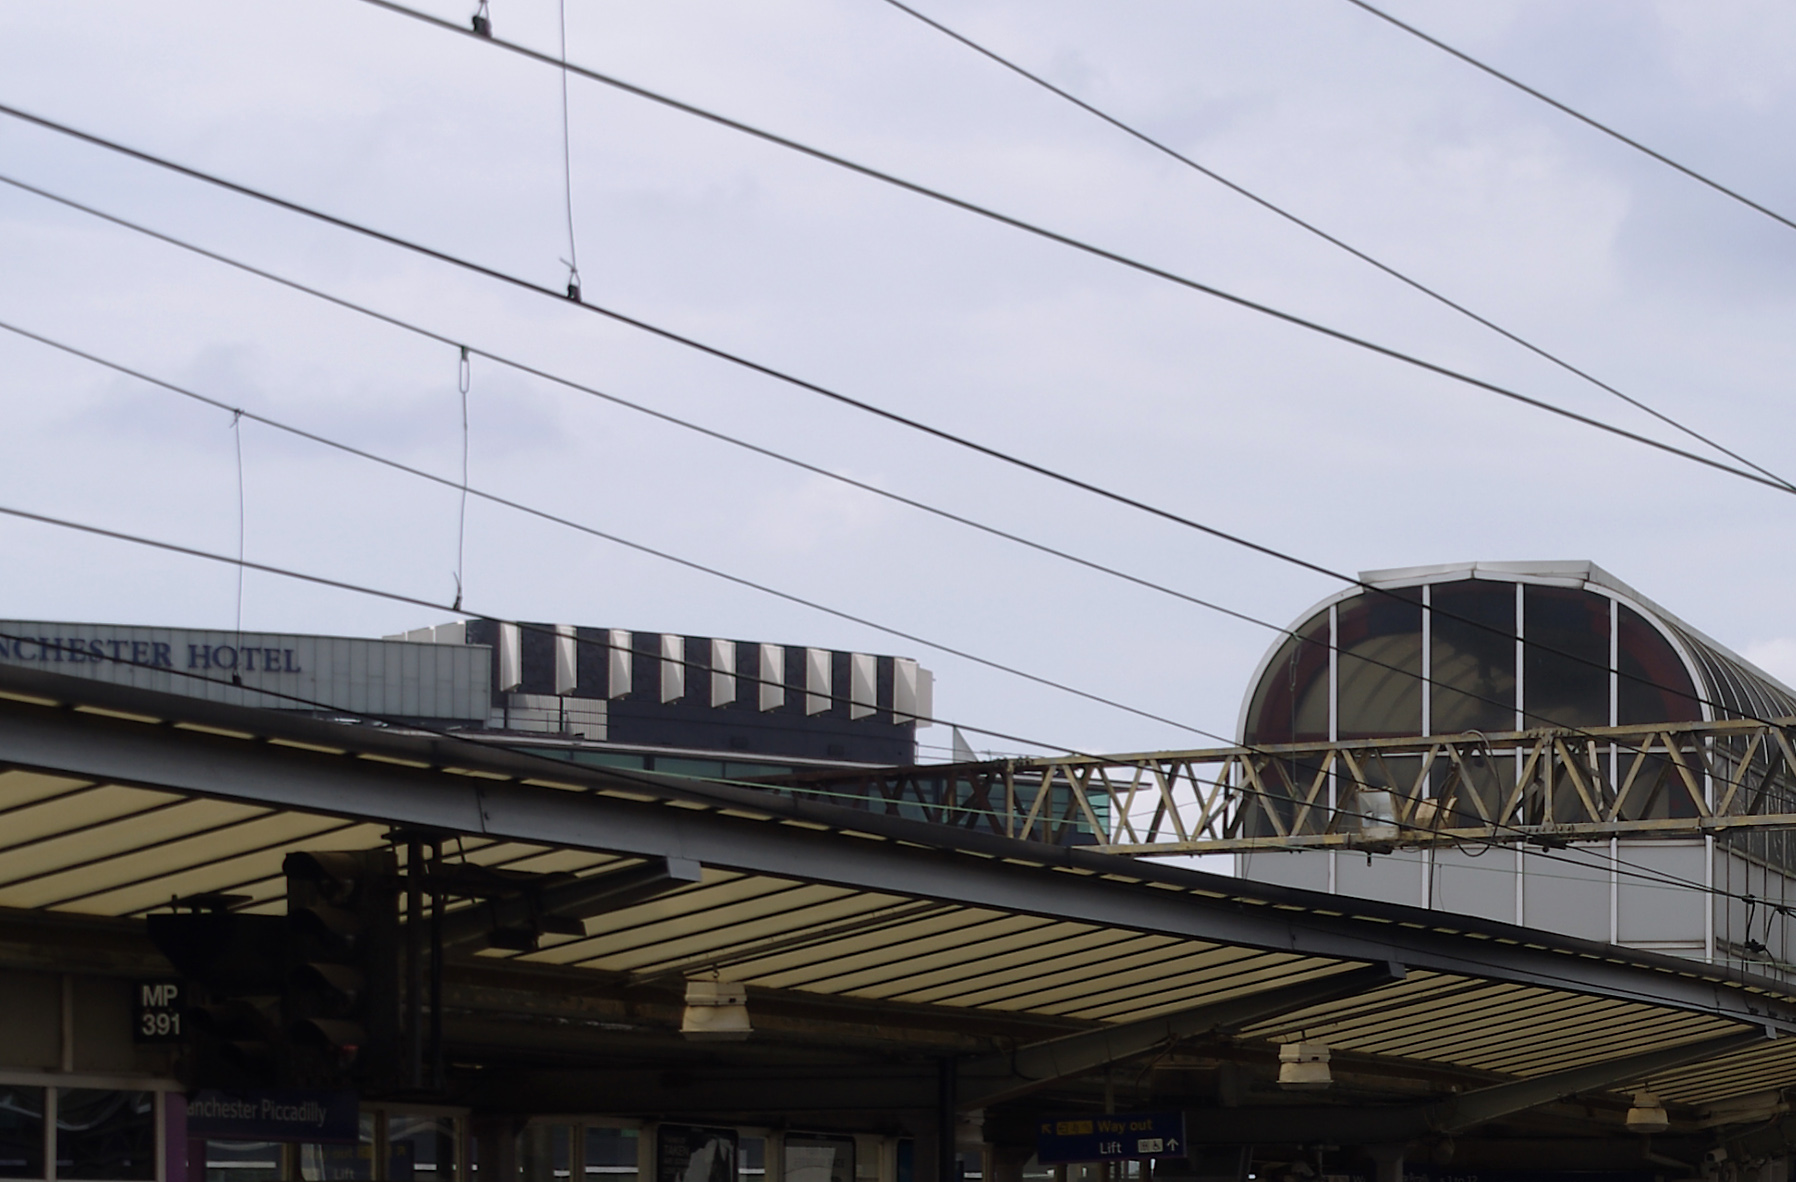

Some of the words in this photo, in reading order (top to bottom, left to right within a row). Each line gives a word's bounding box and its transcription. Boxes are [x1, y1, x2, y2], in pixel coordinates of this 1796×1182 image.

[187, 644, 302, 673] HOTEL
[141, 984, 179, 1008] MP
[141, 1013, 181, 1036] 391
[260, 1097, 327, 1127] Piccadilly
[1097, 1119, 1126, 1134] Way
[1129, 1118, 1153, 1131] out
[1099, 1141, 1122, 1154] Lift
